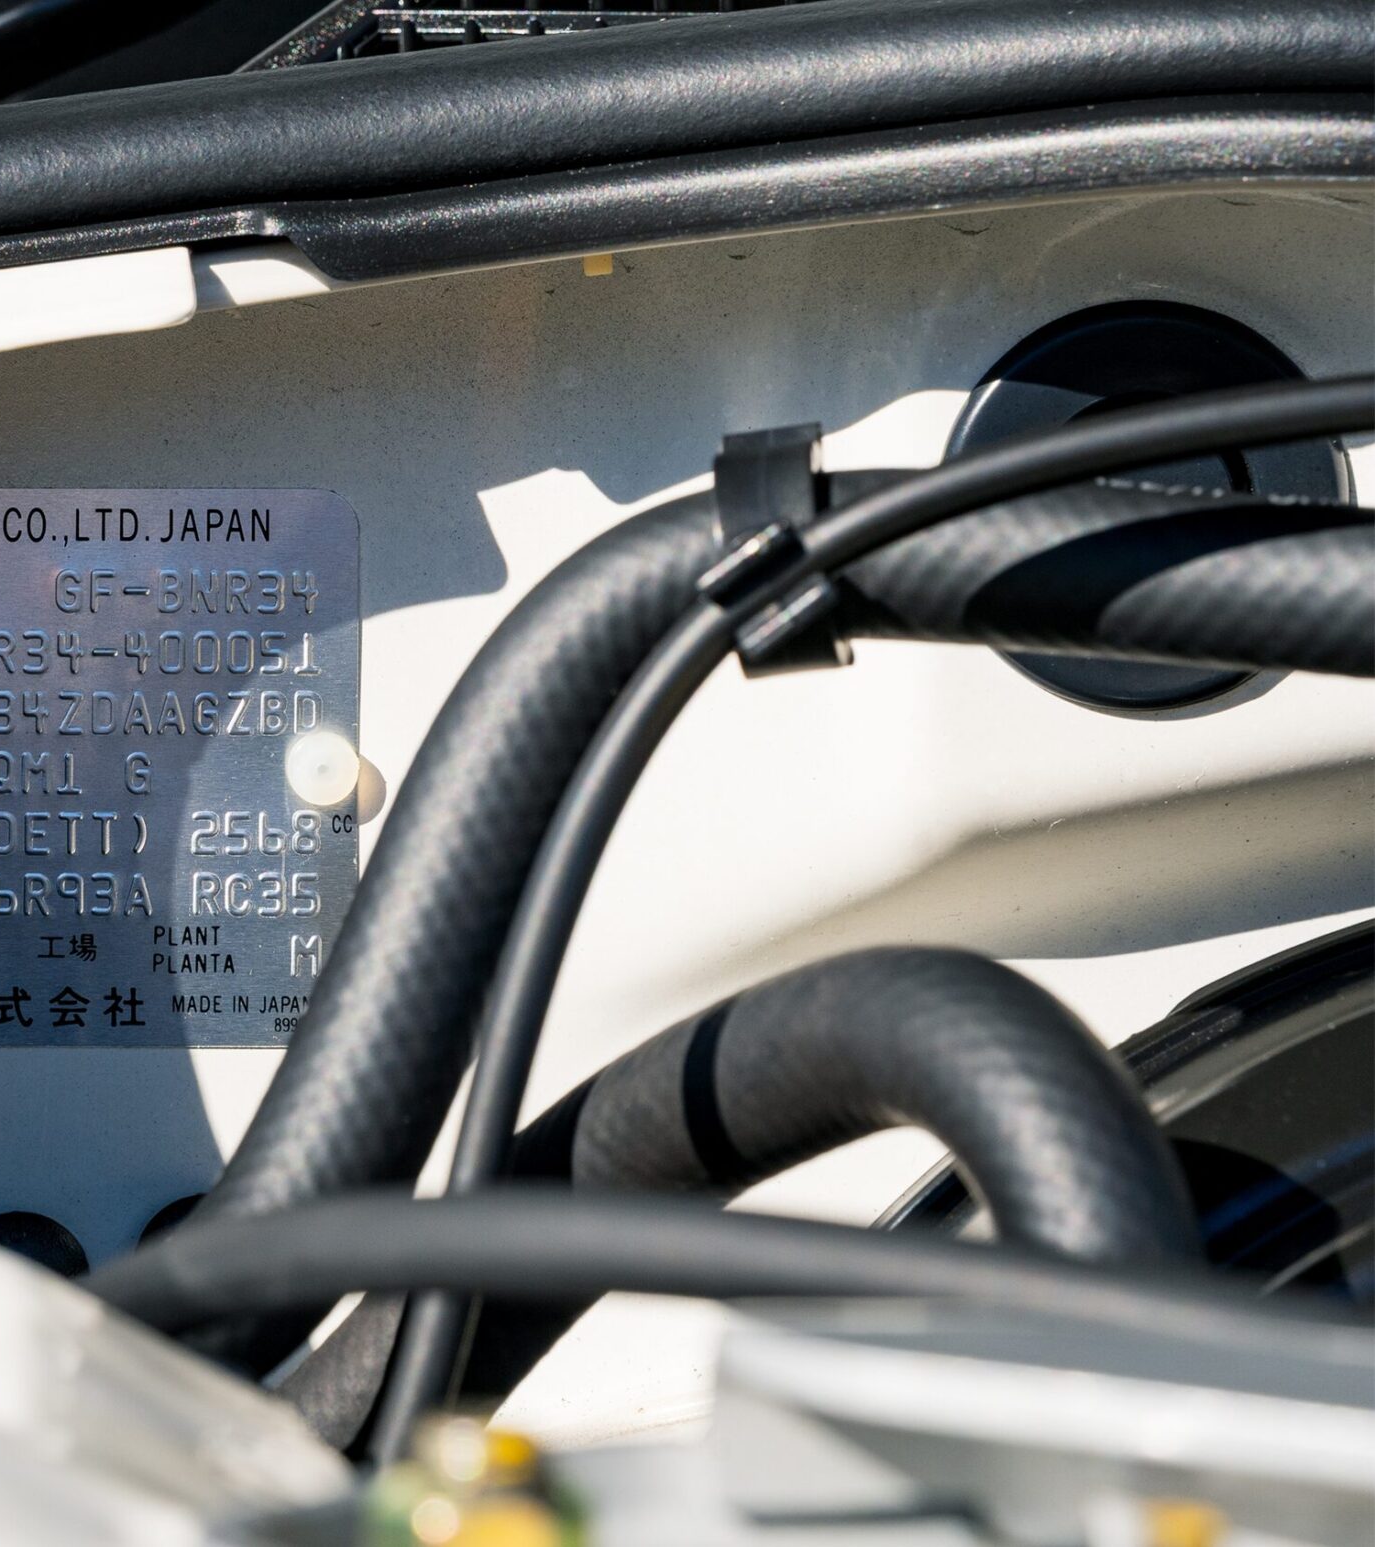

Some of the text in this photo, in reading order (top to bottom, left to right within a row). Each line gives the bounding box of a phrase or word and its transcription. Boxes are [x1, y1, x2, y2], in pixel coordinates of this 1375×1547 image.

[160, 507, 271, 543] JAPAN
[55, 568, 320, 614] GF-BNR34
[125, 751, 152, 795] G
[191, 810, 322, 855] 2568
[331, 815, 353, 834] CC
[192, 871, 322, 918] RC35
[37, 934, 98, 962] 工場
[153, 926, 221, 946] PLANT
[152, 953, 235, 974] PLANTA
[289, 934, 323, 979] M
[172, 996, 223, 1014] MADE
[233, 995, 249, 1014] IN
